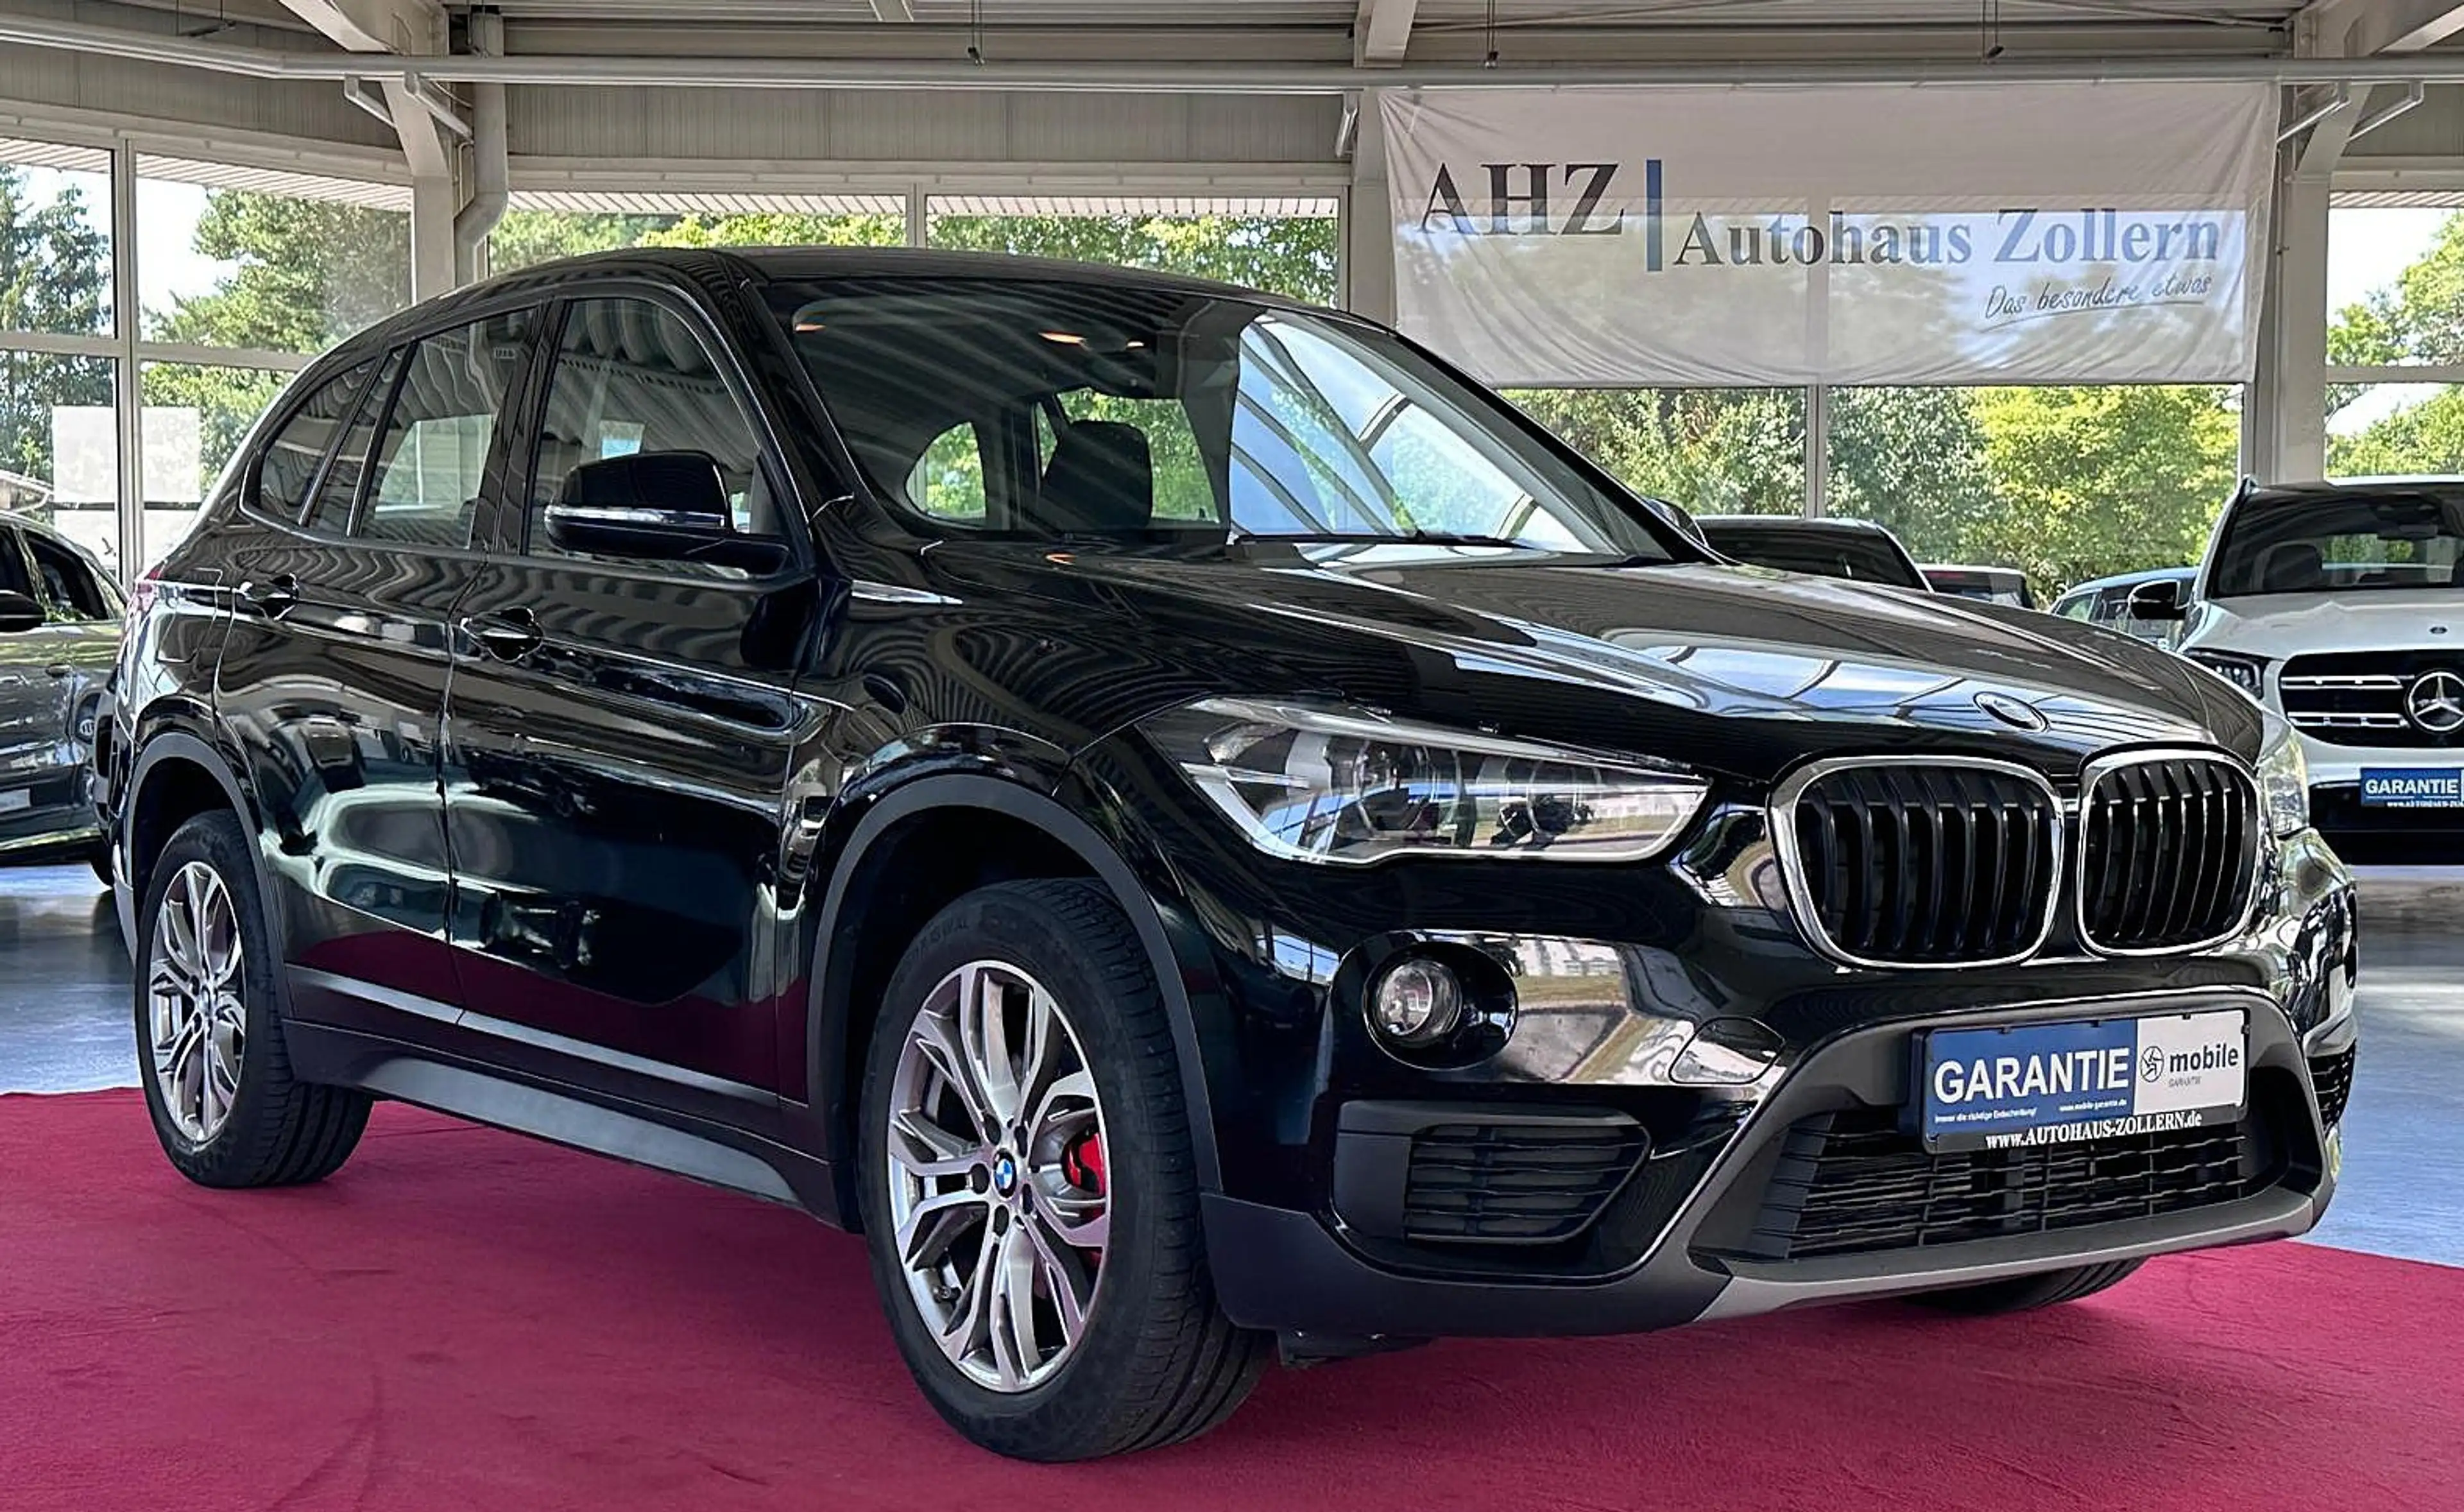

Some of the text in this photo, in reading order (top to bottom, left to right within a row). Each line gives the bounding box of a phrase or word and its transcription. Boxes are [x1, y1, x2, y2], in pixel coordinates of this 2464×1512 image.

[1416, 161, 1625, 236] AHZ
[1672, 207, 2218, 265] Autohaus Zollern
[1985, 271, 2212, 319] Das besondere etwas
[2365, 778, 2460, 795] GARANTIE
[1933, 1047, 2130, 1104] GARANTIE
[2169, 1042, 2239, 1072] mobile
[1985, 1110, 2203, 1149] www.AUTOHAUS-ZOLLERN.de
